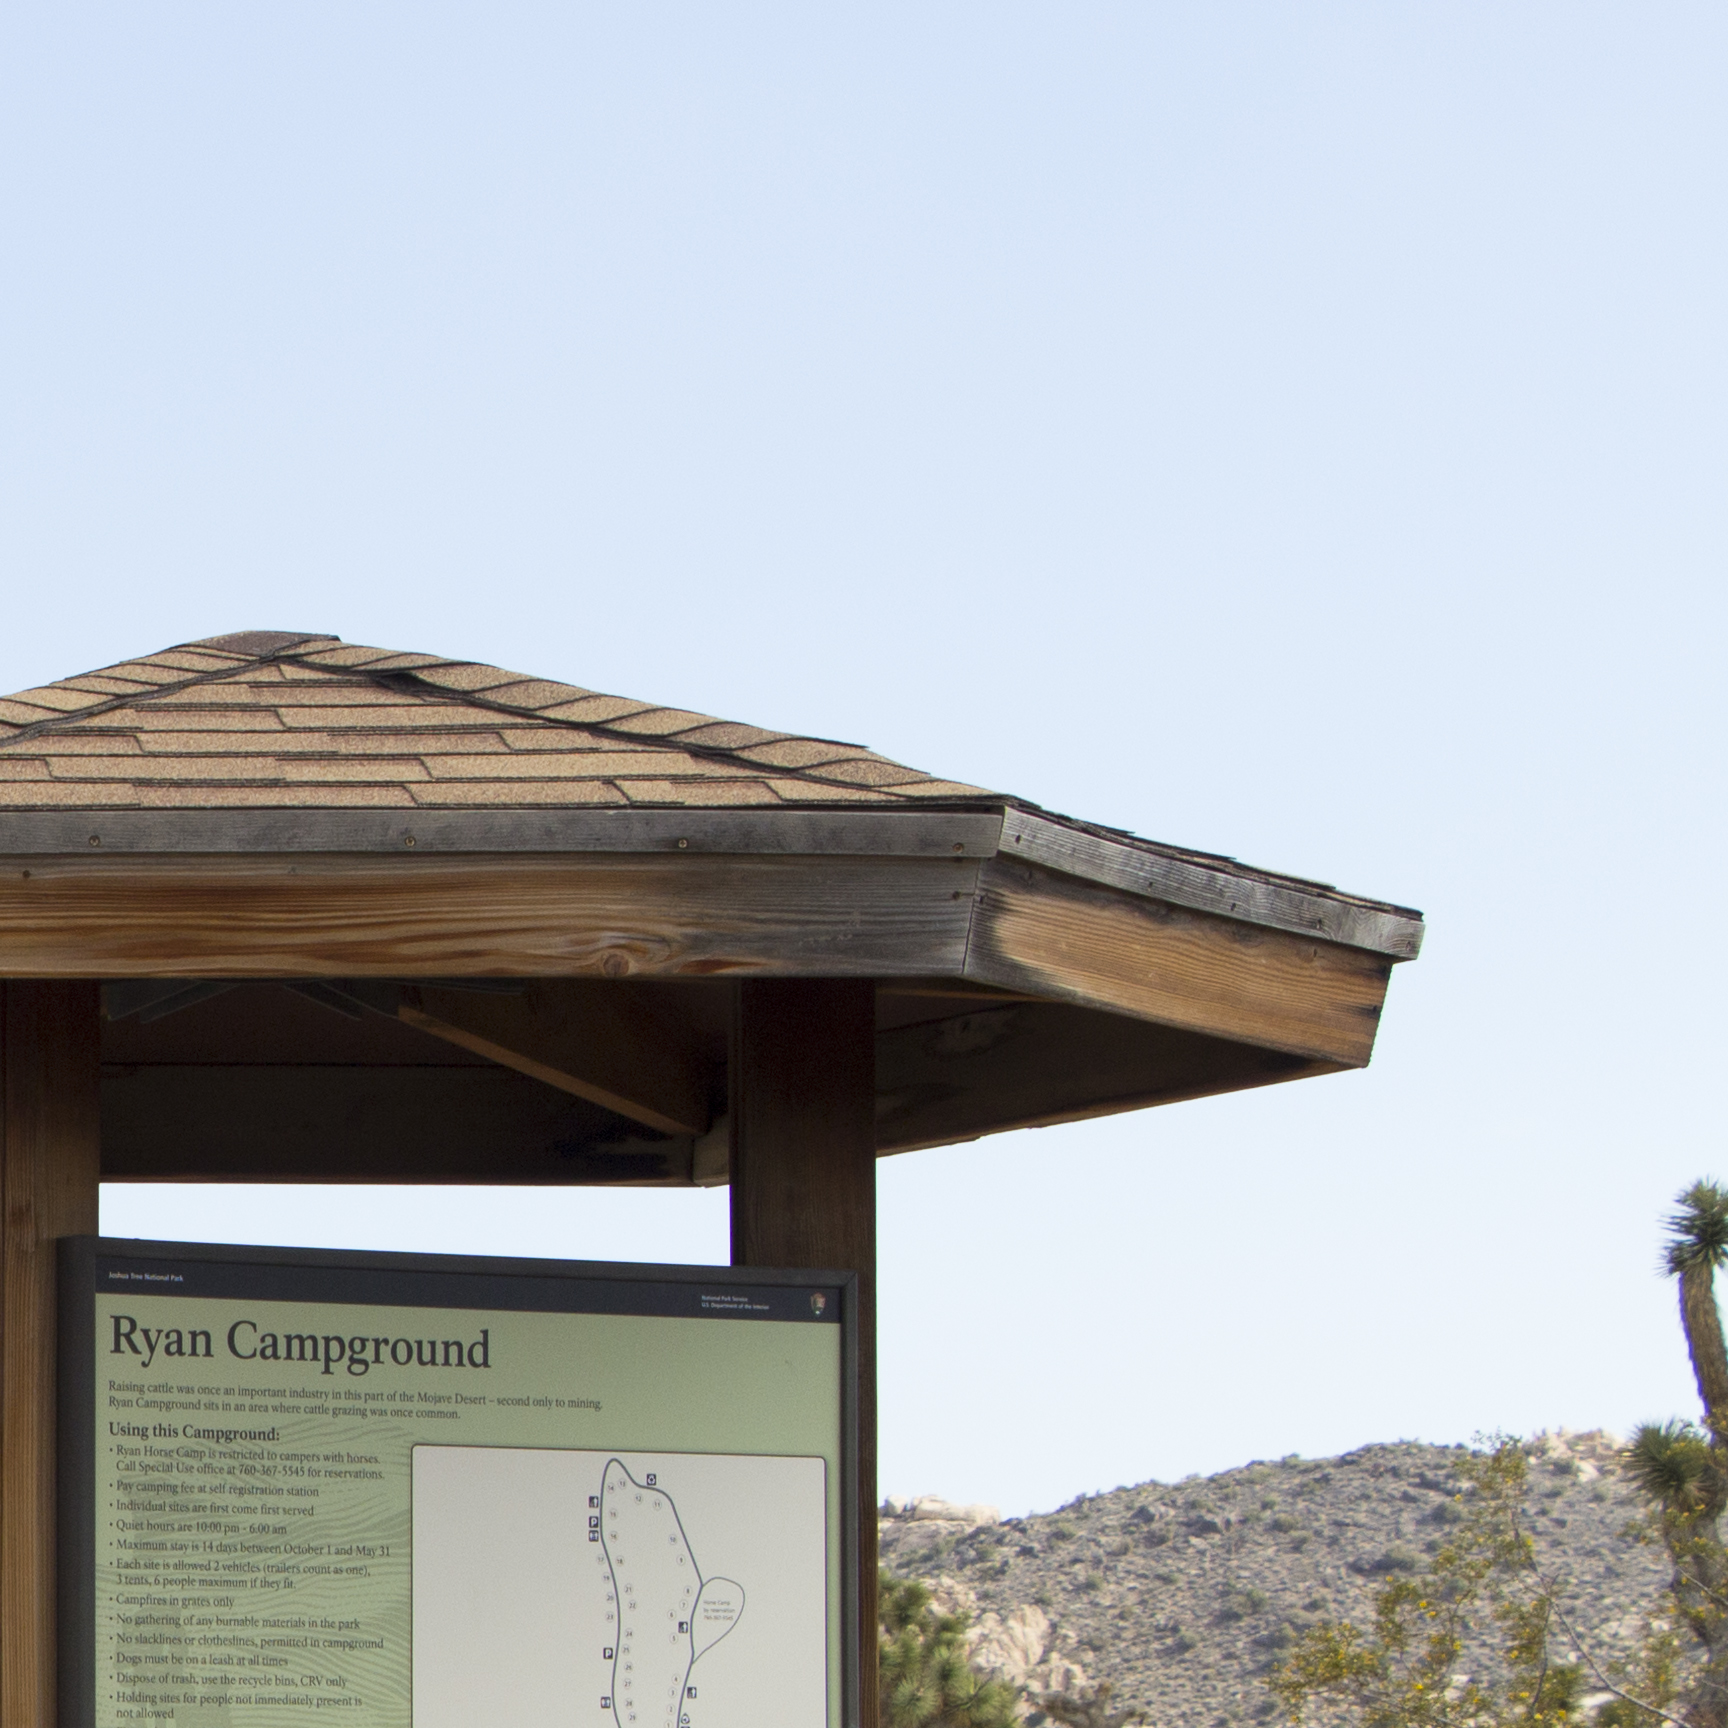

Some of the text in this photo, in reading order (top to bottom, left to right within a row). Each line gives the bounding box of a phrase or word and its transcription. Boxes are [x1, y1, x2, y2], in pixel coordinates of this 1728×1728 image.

[109, 1271, 129, 1279] Joshua
[131, 1272, 143, 1280] Tree
[145, 1273, 169, 1281] National
[109, 1314, 492, 1377] Ryan Campground
[108, 1380, 145, 1396] Raising
[146, 1381, 174, 1393] cattle
[176, 1385, 195, 1394] was
[197, 1386, 221, 1396] once
[223, 1387, 235, 1396] an
[237, 1385, 286, 1400] important
[289, 1387, 329, 1402] industry
[331, 1389, 341, 1400] in
[344, 1388, 362, 1400] this
[364, 1392, 384, 1404] part
[386, 1390, 397, 1401] of
[399, 1390, 414, 1402] the
[417, 1391, 452, 1405] Mojave
[454, 1392, 486, 1405] Desert
[496, 1394, 530, 1406] second
[532, 1395, 553, 1410] only
[555, 1398, 565, 1407] to
[567, 1397, 602, 1411] mining.
[108, 1395, 460, 1419] Ryan Campground sits in an area where cattle grazing was once common.
[109, 1421, 279, 1444] Using this Campground:
[116, 1480, 319, 1497] Pay camping fee at self registration station
[115, 1519, 144, 1532] Quiet
[146, 1520, 175, 1531] hours
[177, 1523, 193, 1532] are
[196, 1521, 221, 1532] 10:00
[223, 1524, 239, 1536] pm
[249, 1523, 270, 1534] 6:00
[271, 1526, 287, 1534] am
[115, 1593, 234, 1609] Campfires in grates only
[116, 1652, 288, 1666] Dogs must be on a leash at all times
